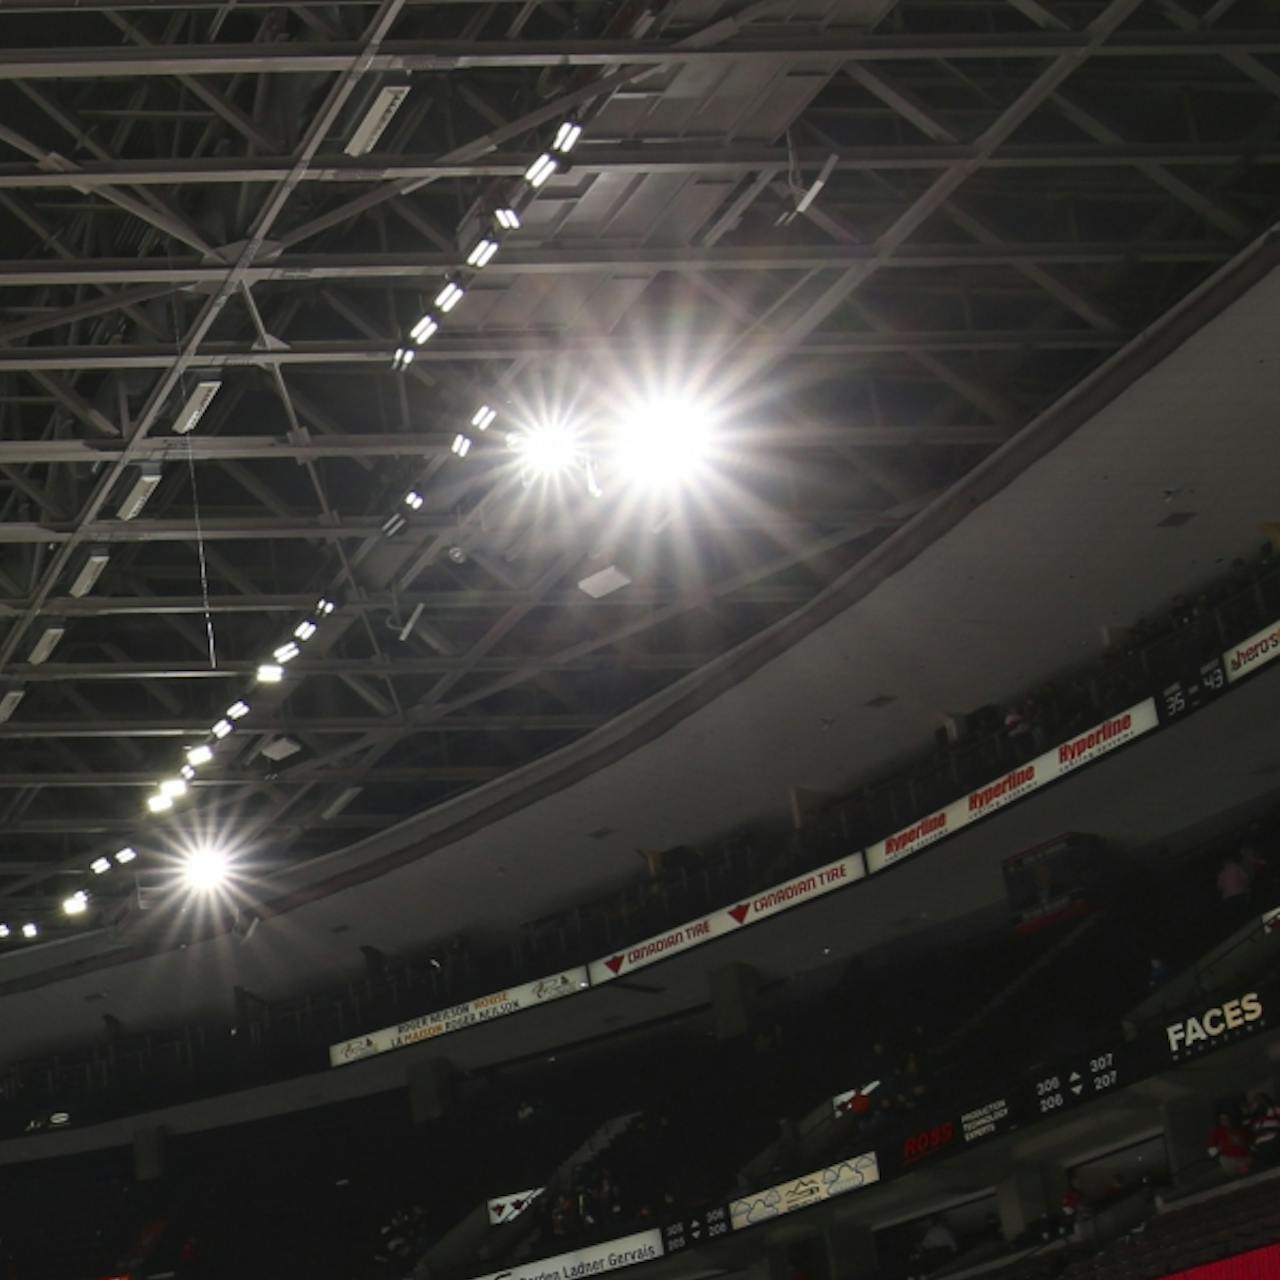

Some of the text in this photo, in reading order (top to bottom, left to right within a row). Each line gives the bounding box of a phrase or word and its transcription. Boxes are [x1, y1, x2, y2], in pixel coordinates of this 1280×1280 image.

[1166, 695, 1185, 717] 35
[1059, 713, 1131, 764] Hyperline
[969, 766, 1035, 811] Hyperline
[754, 864, 847, 913] CANADIAN TIRE
[628, 919, 711, 963] CANADIAN TIRE
[1165, 992, 1264, 1052] FACES
[1089, 1053, 1114, 1072] 307
[1094, 1071, 1118, 1091] 207
[563, 1257, 605, 1280] Ladner
[608, 1243, 656, 1267] Gervais
